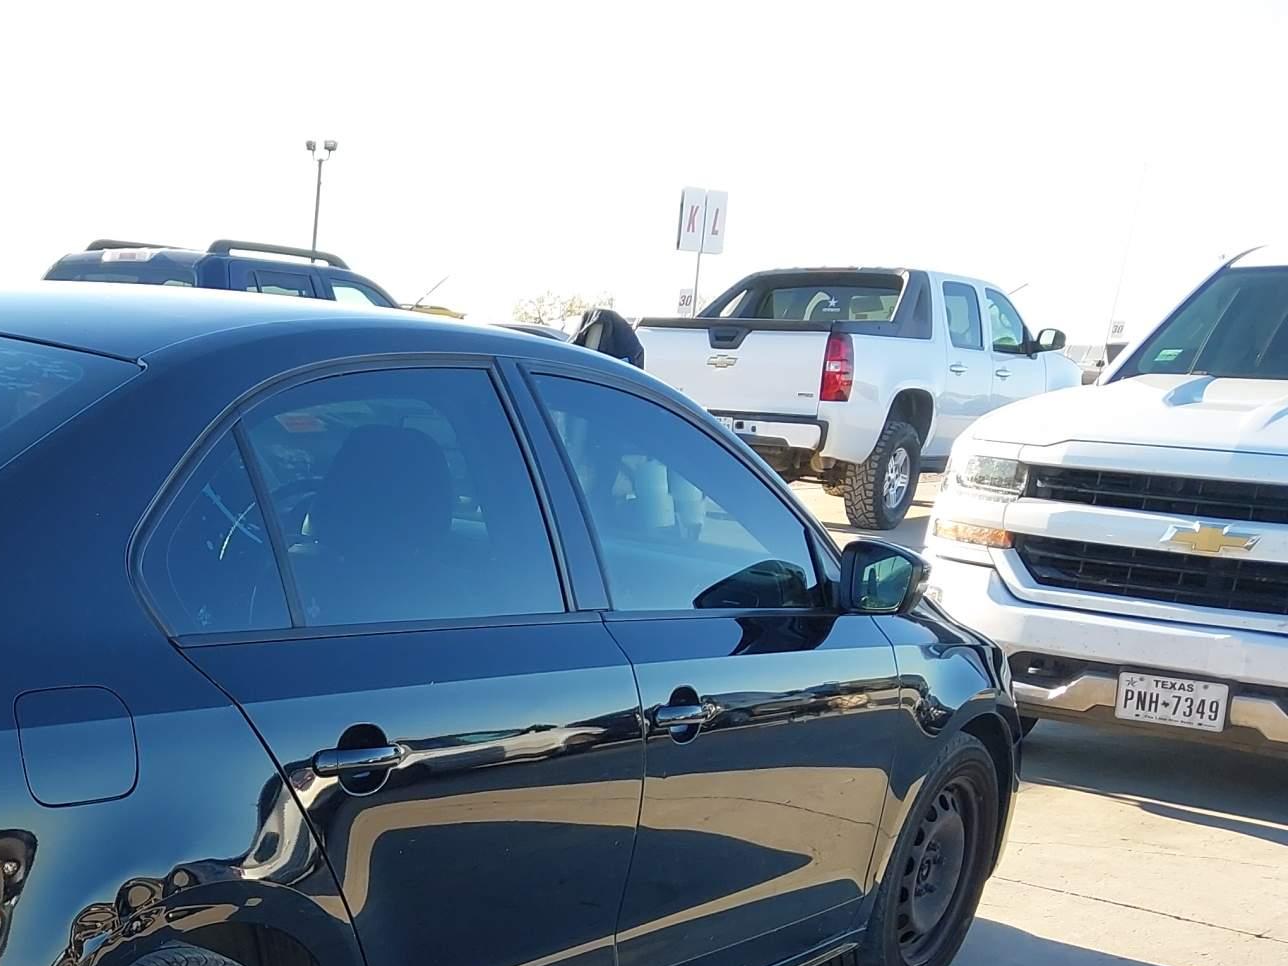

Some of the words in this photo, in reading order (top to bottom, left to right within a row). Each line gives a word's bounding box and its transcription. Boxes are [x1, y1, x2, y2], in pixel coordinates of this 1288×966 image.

[687, 205, 700, 233] K
[711, 207, 720, 235] L
[679, 295, 692, 307] 30
[1153, 679, 1194, 693] TEXAS
